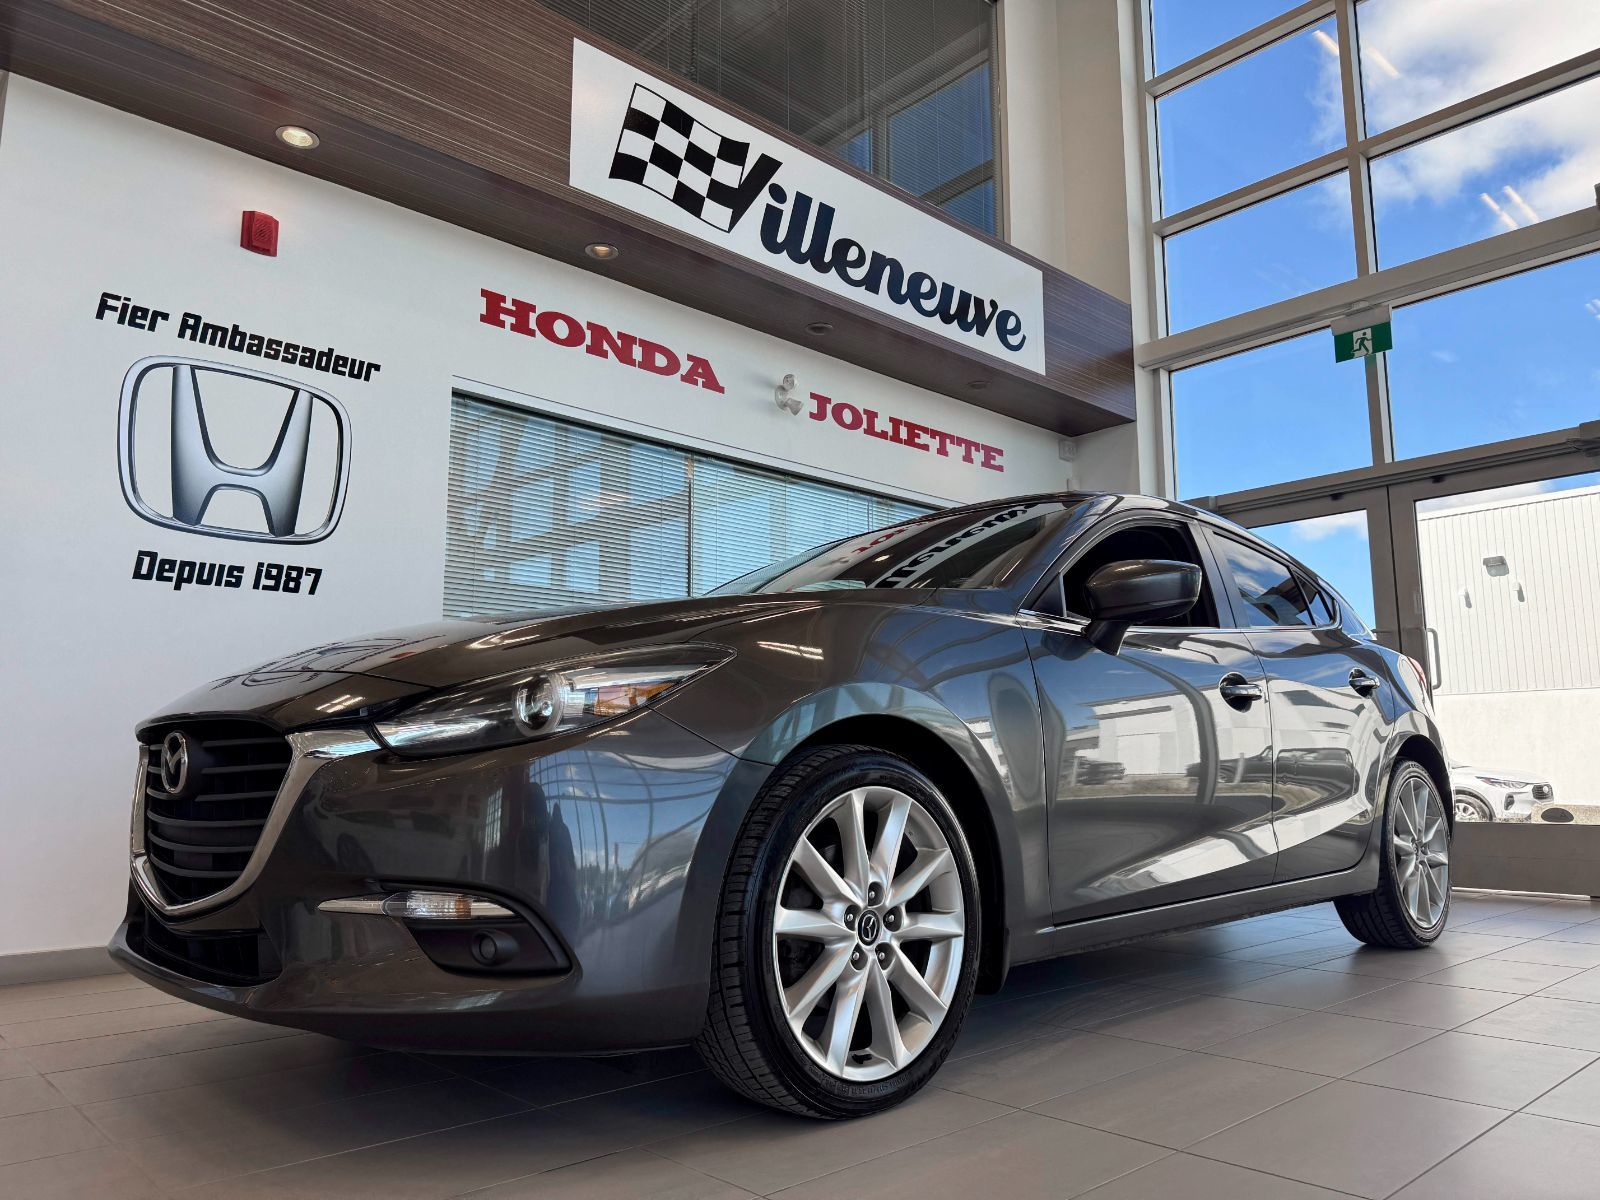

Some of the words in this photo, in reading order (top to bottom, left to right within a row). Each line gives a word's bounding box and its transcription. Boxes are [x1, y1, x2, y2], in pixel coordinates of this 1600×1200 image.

[690, 142, 1027, 353] Villeneuve
[95, 292, 170, 332] Fier
[177, 312, 381, 382] Ambassadeur
[480, 289, 724, 393] HONDA
[809, 391, 1005, 472] JOLIETTE
[132, 550, 244, 591] Depuis
[253, 562, 323, 596] 1987
